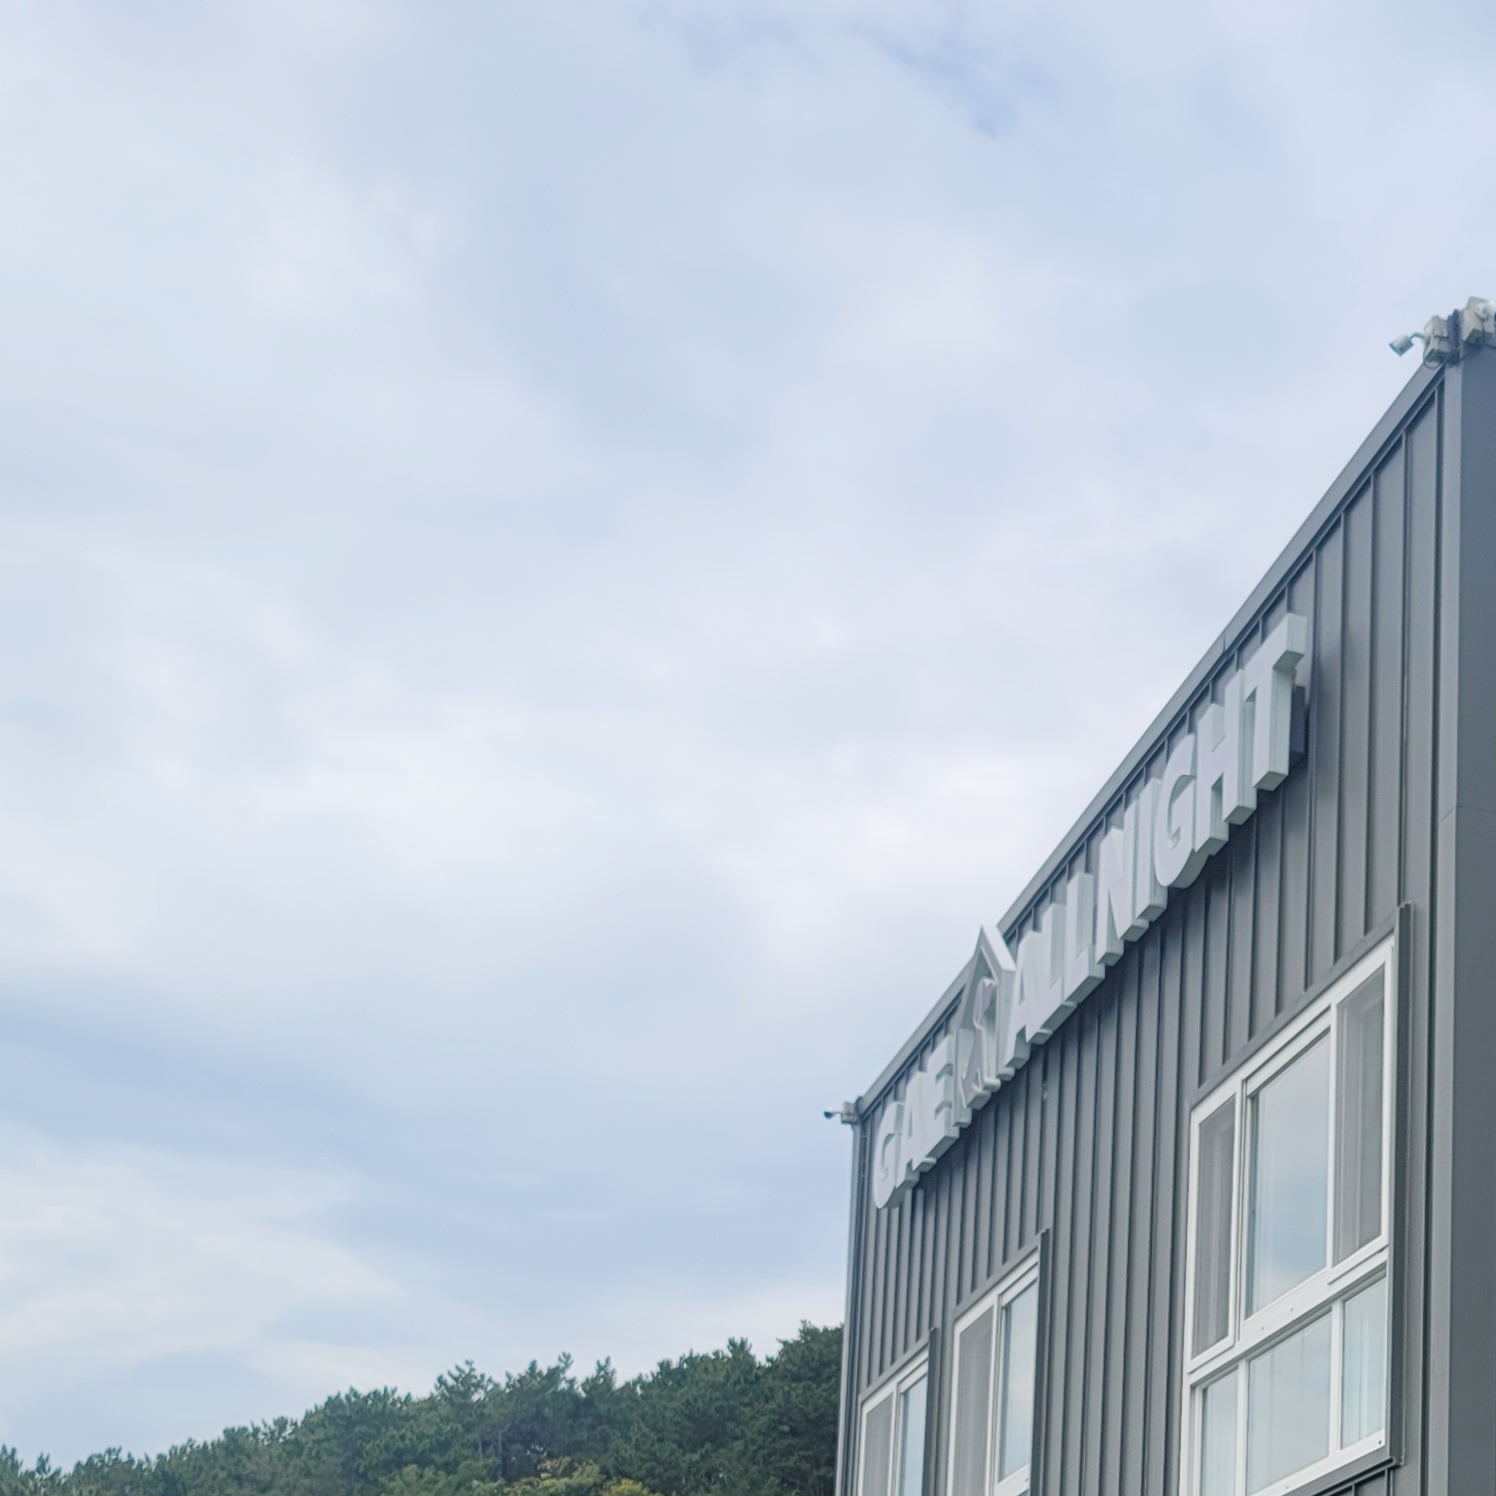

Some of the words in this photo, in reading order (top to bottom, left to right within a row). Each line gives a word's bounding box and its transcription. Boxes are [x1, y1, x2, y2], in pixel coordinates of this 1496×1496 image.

[872, 1032, 960, 1209] GAE
[1002, 870, 1105, 1082] ALL
[1096, 613, 1307, 966] NIGHT
